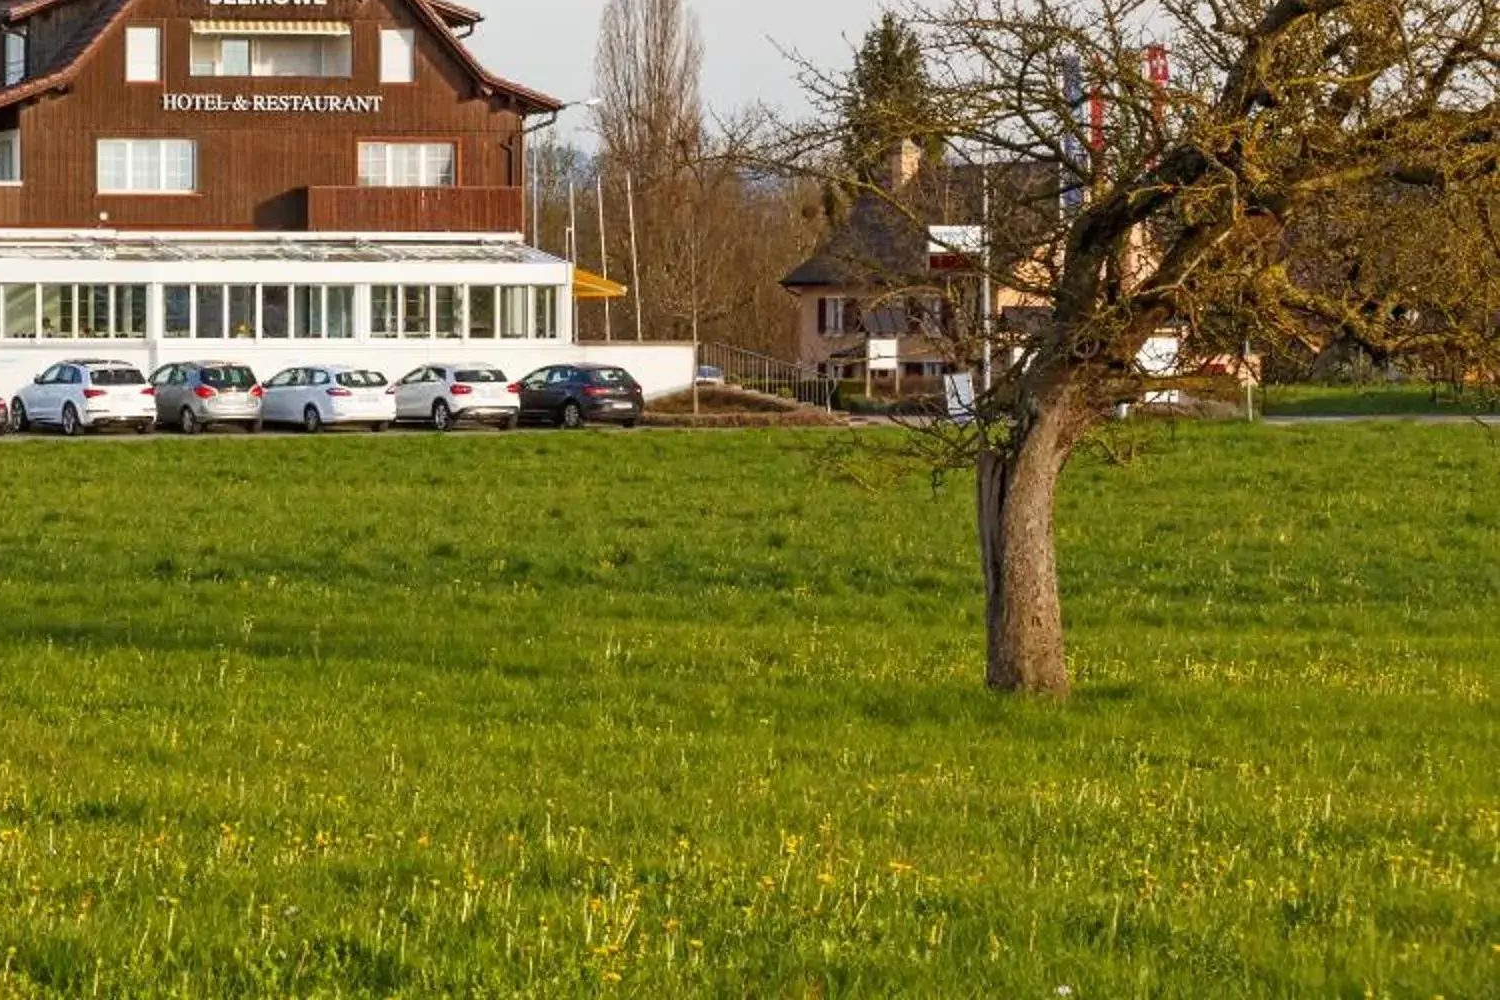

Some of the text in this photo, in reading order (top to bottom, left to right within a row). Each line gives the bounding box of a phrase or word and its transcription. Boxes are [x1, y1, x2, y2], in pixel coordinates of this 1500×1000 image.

[162, 93, 383, 112] HOTEL & RESTAURANT
